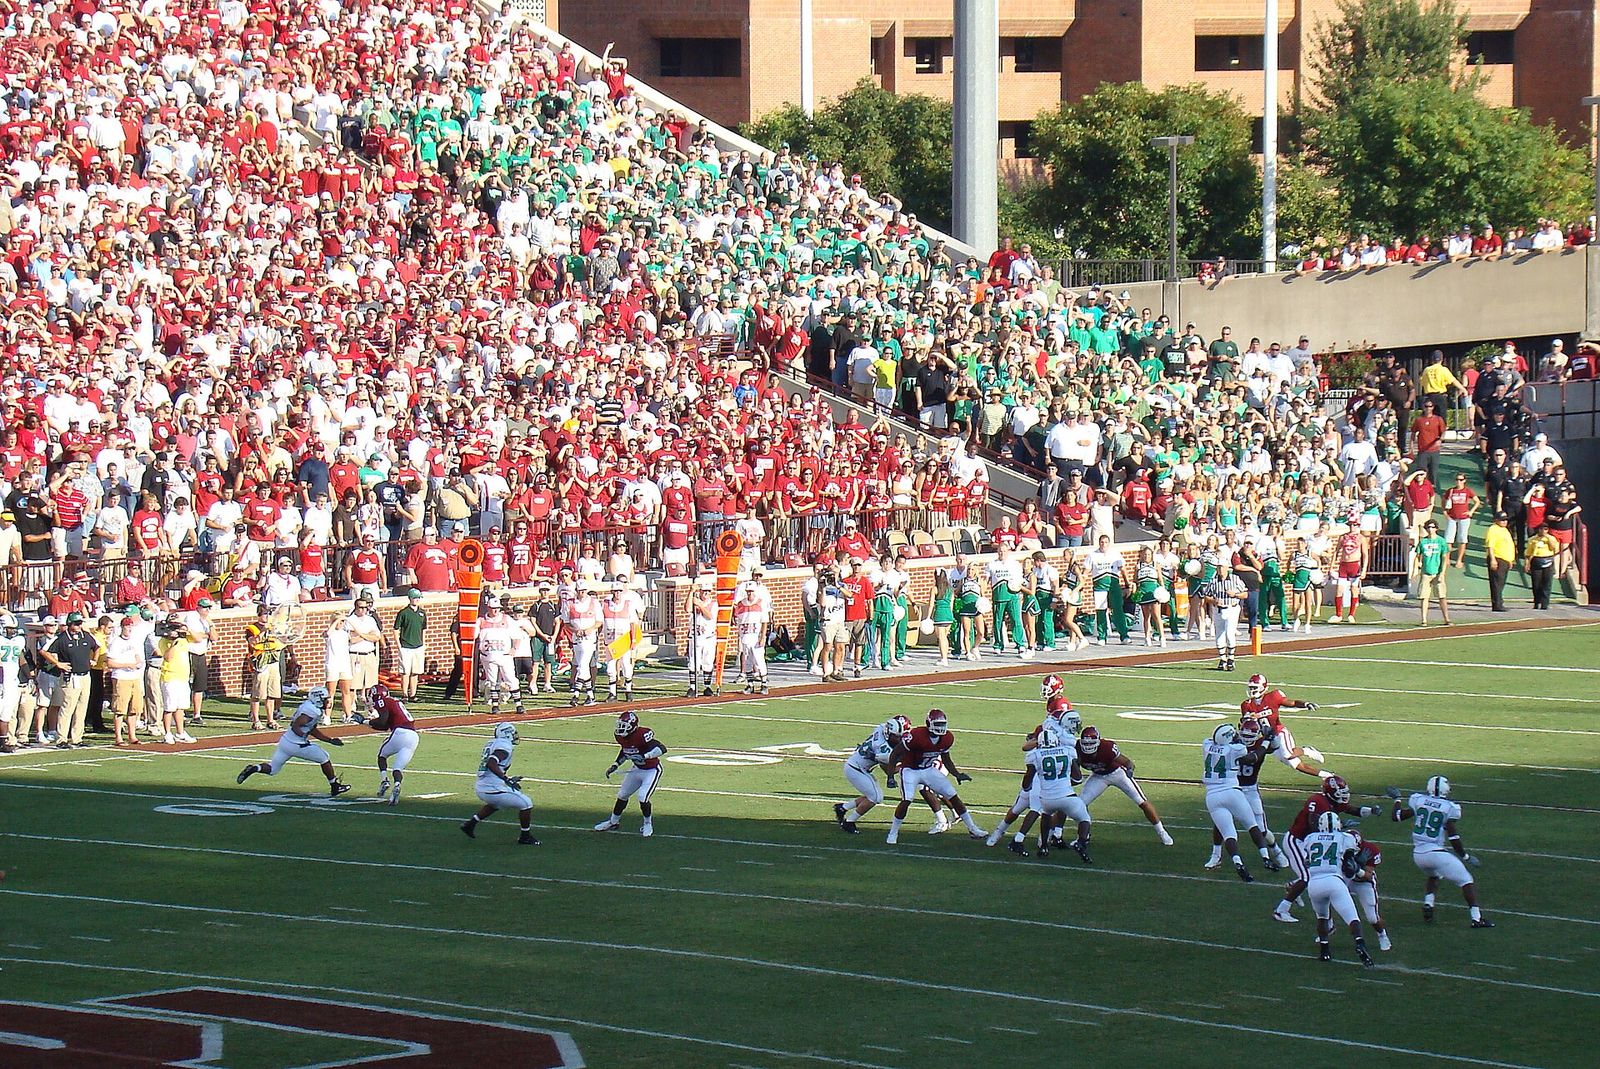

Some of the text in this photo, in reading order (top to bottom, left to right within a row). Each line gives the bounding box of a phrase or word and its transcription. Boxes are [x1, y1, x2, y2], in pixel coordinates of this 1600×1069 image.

[643, 730, 654, 743] 22
[1042, 756, 1069, 781] 97
[1205, 753, 1227, 779] 44
[1308, 801, 1317, 812] 5
[1413, 807, 1444, 838] 39
[1310, 842, 1338, 867] 24
